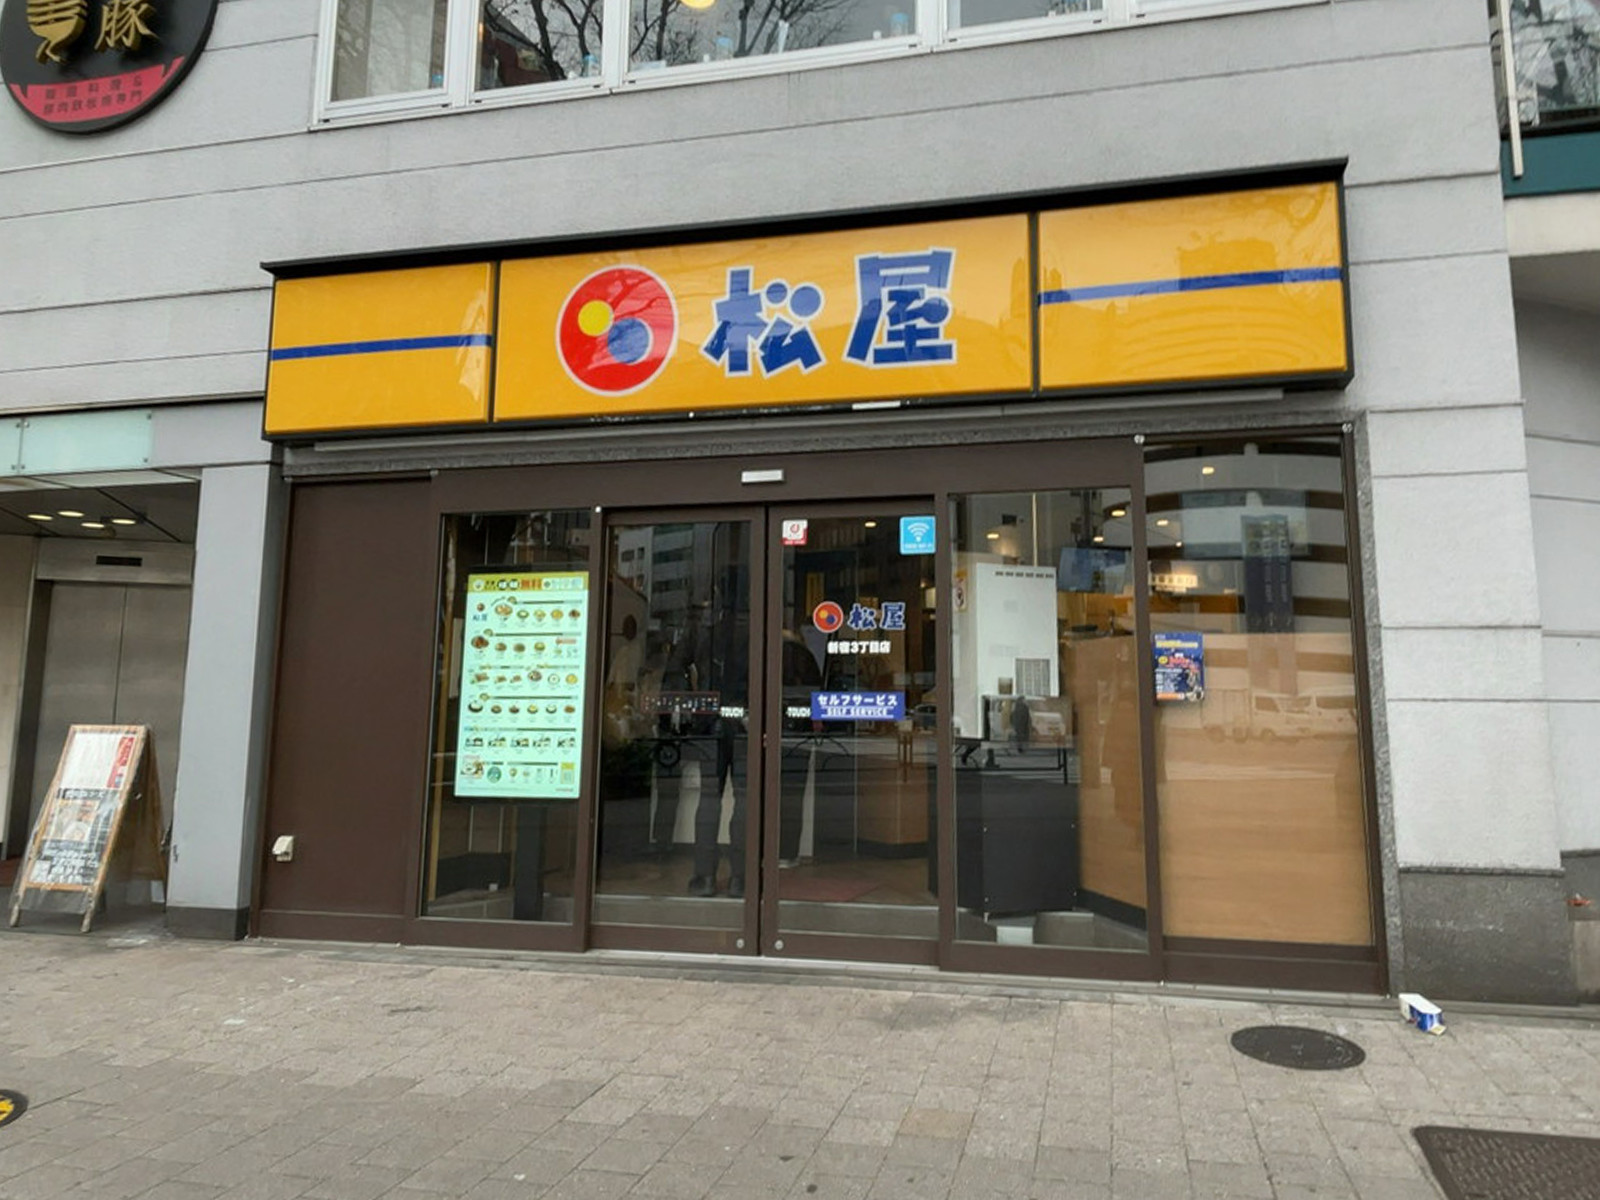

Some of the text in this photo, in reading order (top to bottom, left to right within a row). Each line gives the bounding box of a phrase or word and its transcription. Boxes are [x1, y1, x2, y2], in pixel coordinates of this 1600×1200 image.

[94, 0, 159, 52] 豚
[698, 246, 958, 379] 松屋
[848, 601, 906, 631] 松屋
[817, 693, 898, 706] セルフサービス
[827, 707, 888, 716] SELF SERVICE
